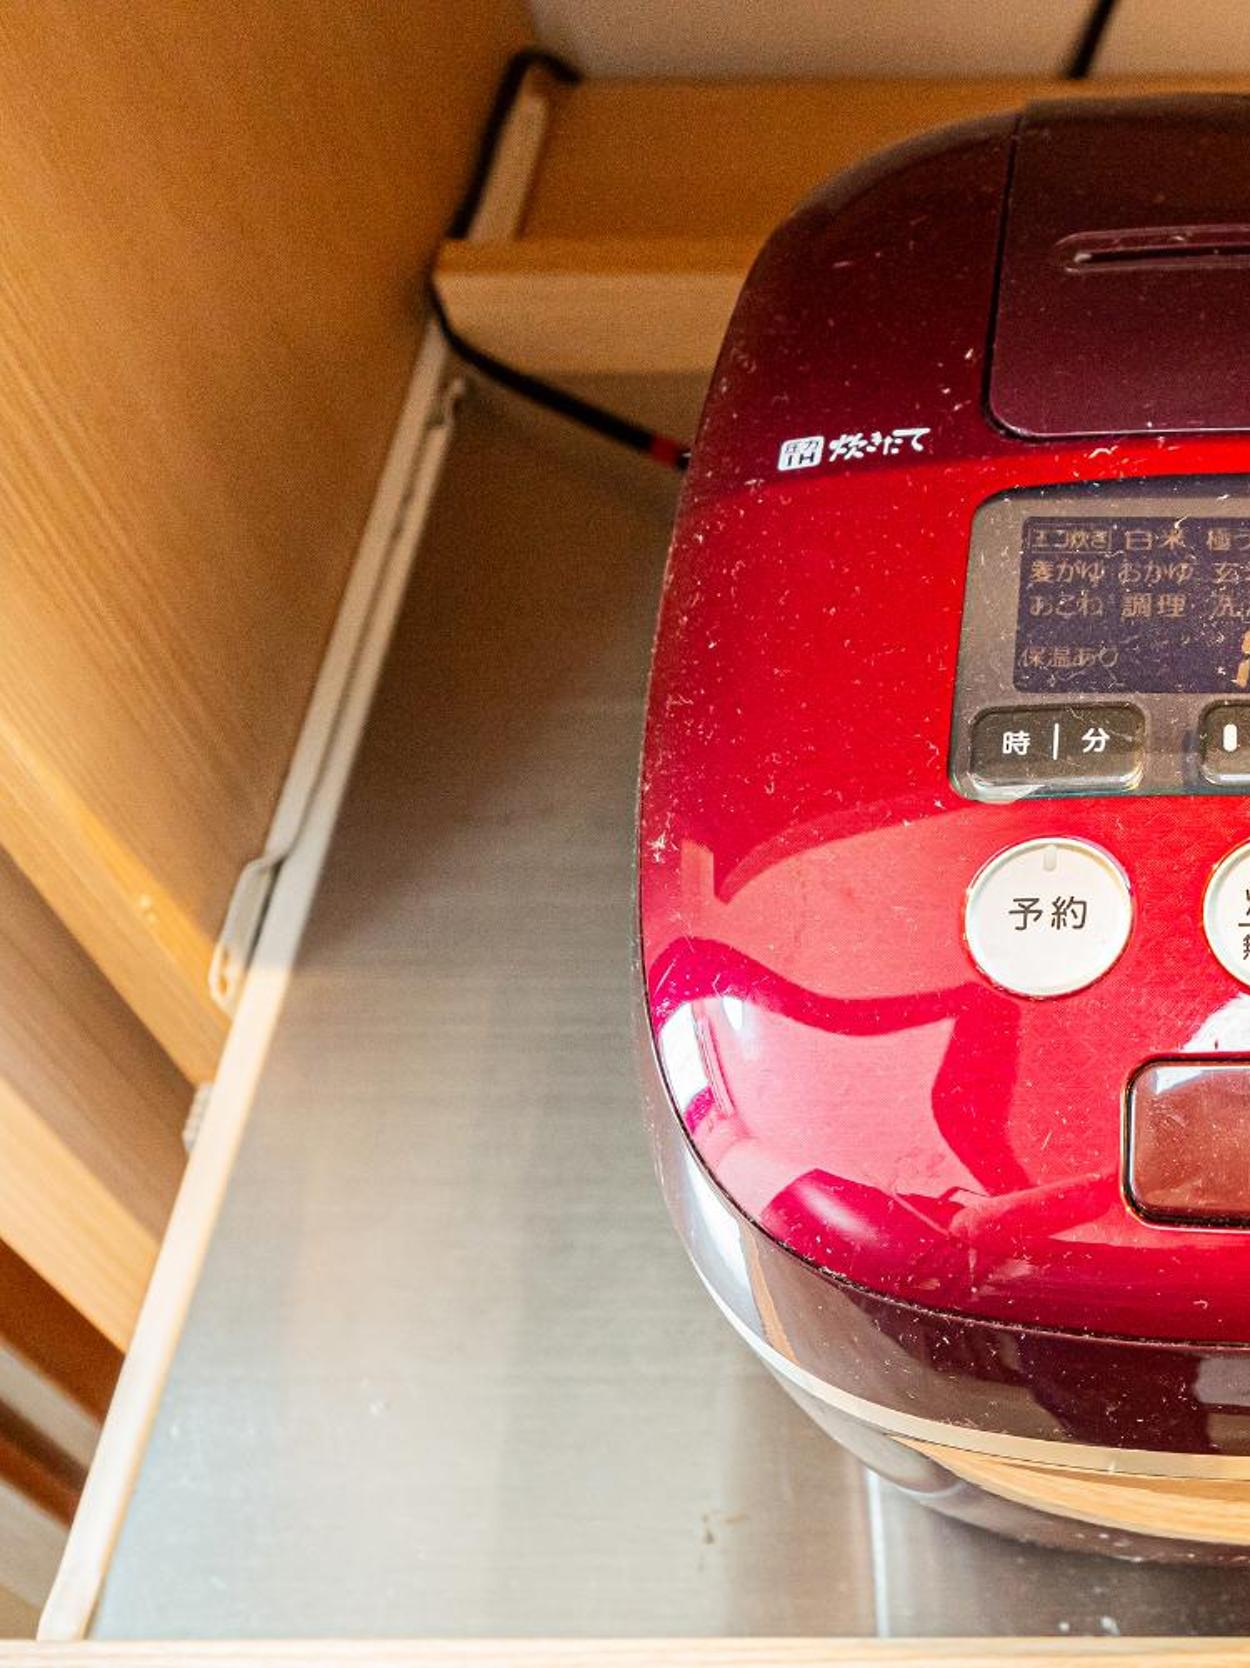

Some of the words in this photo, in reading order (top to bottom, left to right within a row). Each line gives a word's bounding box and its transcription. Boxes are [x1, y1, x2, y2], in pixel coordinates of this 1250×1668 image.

[829, 427, 931, 462] 炊きたて
[787, 451, 816, 466] IH
[1031, 528, 1109, 548] エコ炊き
[1125, 528, 1188, 550] 白米
[1118, 561, 1193, 586] おかゆ
[1121, 593, 1187, 618] 調理
[1002, 731, 1030, 756] 時
[1082, 728, 1110, 752] 分
[1008, 896, 1088, 932] 予約
